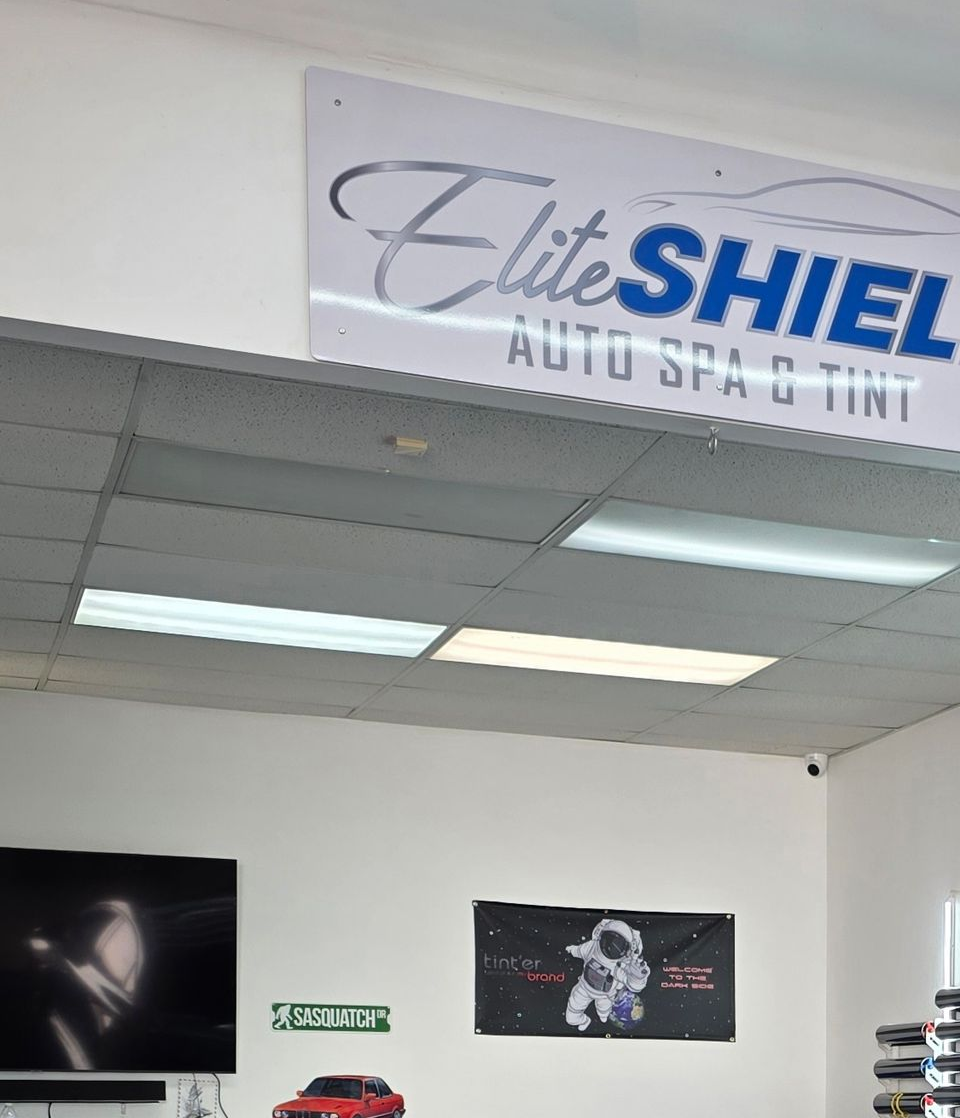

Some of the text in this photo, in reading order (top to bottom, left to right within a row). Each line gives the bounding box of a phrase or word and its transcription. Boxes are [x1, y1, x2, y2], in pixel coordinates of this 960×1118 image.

[329, 160, 618, 312] Elite
[507, 314, 916, 423] AUTO SPA & TINT
[527, 971, 565, 982] brand
[662, 966, 713, 974] WELCOME
[293, 1007, 387, 1029] SASQUATCH DR
